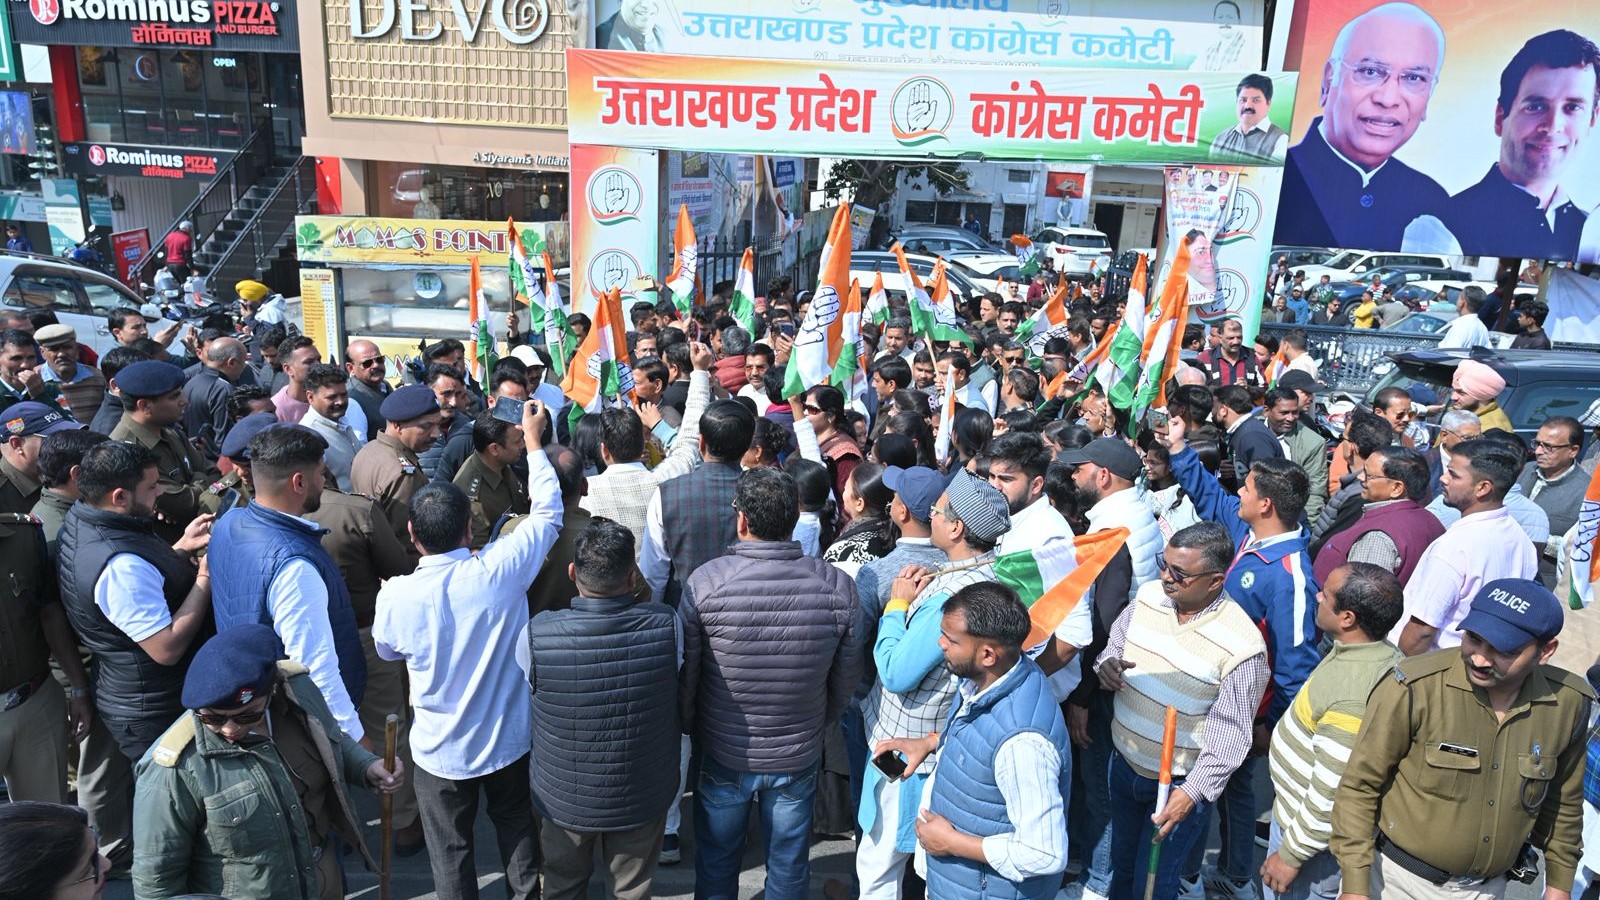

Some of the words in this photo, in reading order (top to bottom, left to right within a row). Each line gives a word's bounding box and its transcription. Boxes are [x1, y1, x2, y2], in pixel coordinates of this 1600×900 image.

[62, 0, 211, 23] Rominus
[350, 0, 549, 45] DEVO
[131, 22, 212, 46] रोमिनस
[215, 24, 237, 34] AND
[238, 25, 279, 35] BURGER
[682, 12, 852, 45] उत्तराखण्ड
[861, 15, 941, 49] प्रदेश
[949, 21, 1062, 56] कांग्रेस
[1070, 26, 1176, 63] कमेटी
[213, 58, 236, 67] OPEN
[597, 80, 781, 131] उत्तराखण्ड
[786, 73, 877, 133] प्रदेश
[970, 80, 1087, 140] कांग्रेस
[1092, 83, 1204, 143] कमेटी
[106, 147, 184, 167] Rominus
[433, 229, 508, 253] POINT
[1488, 588, 1531, 614] POLICE
